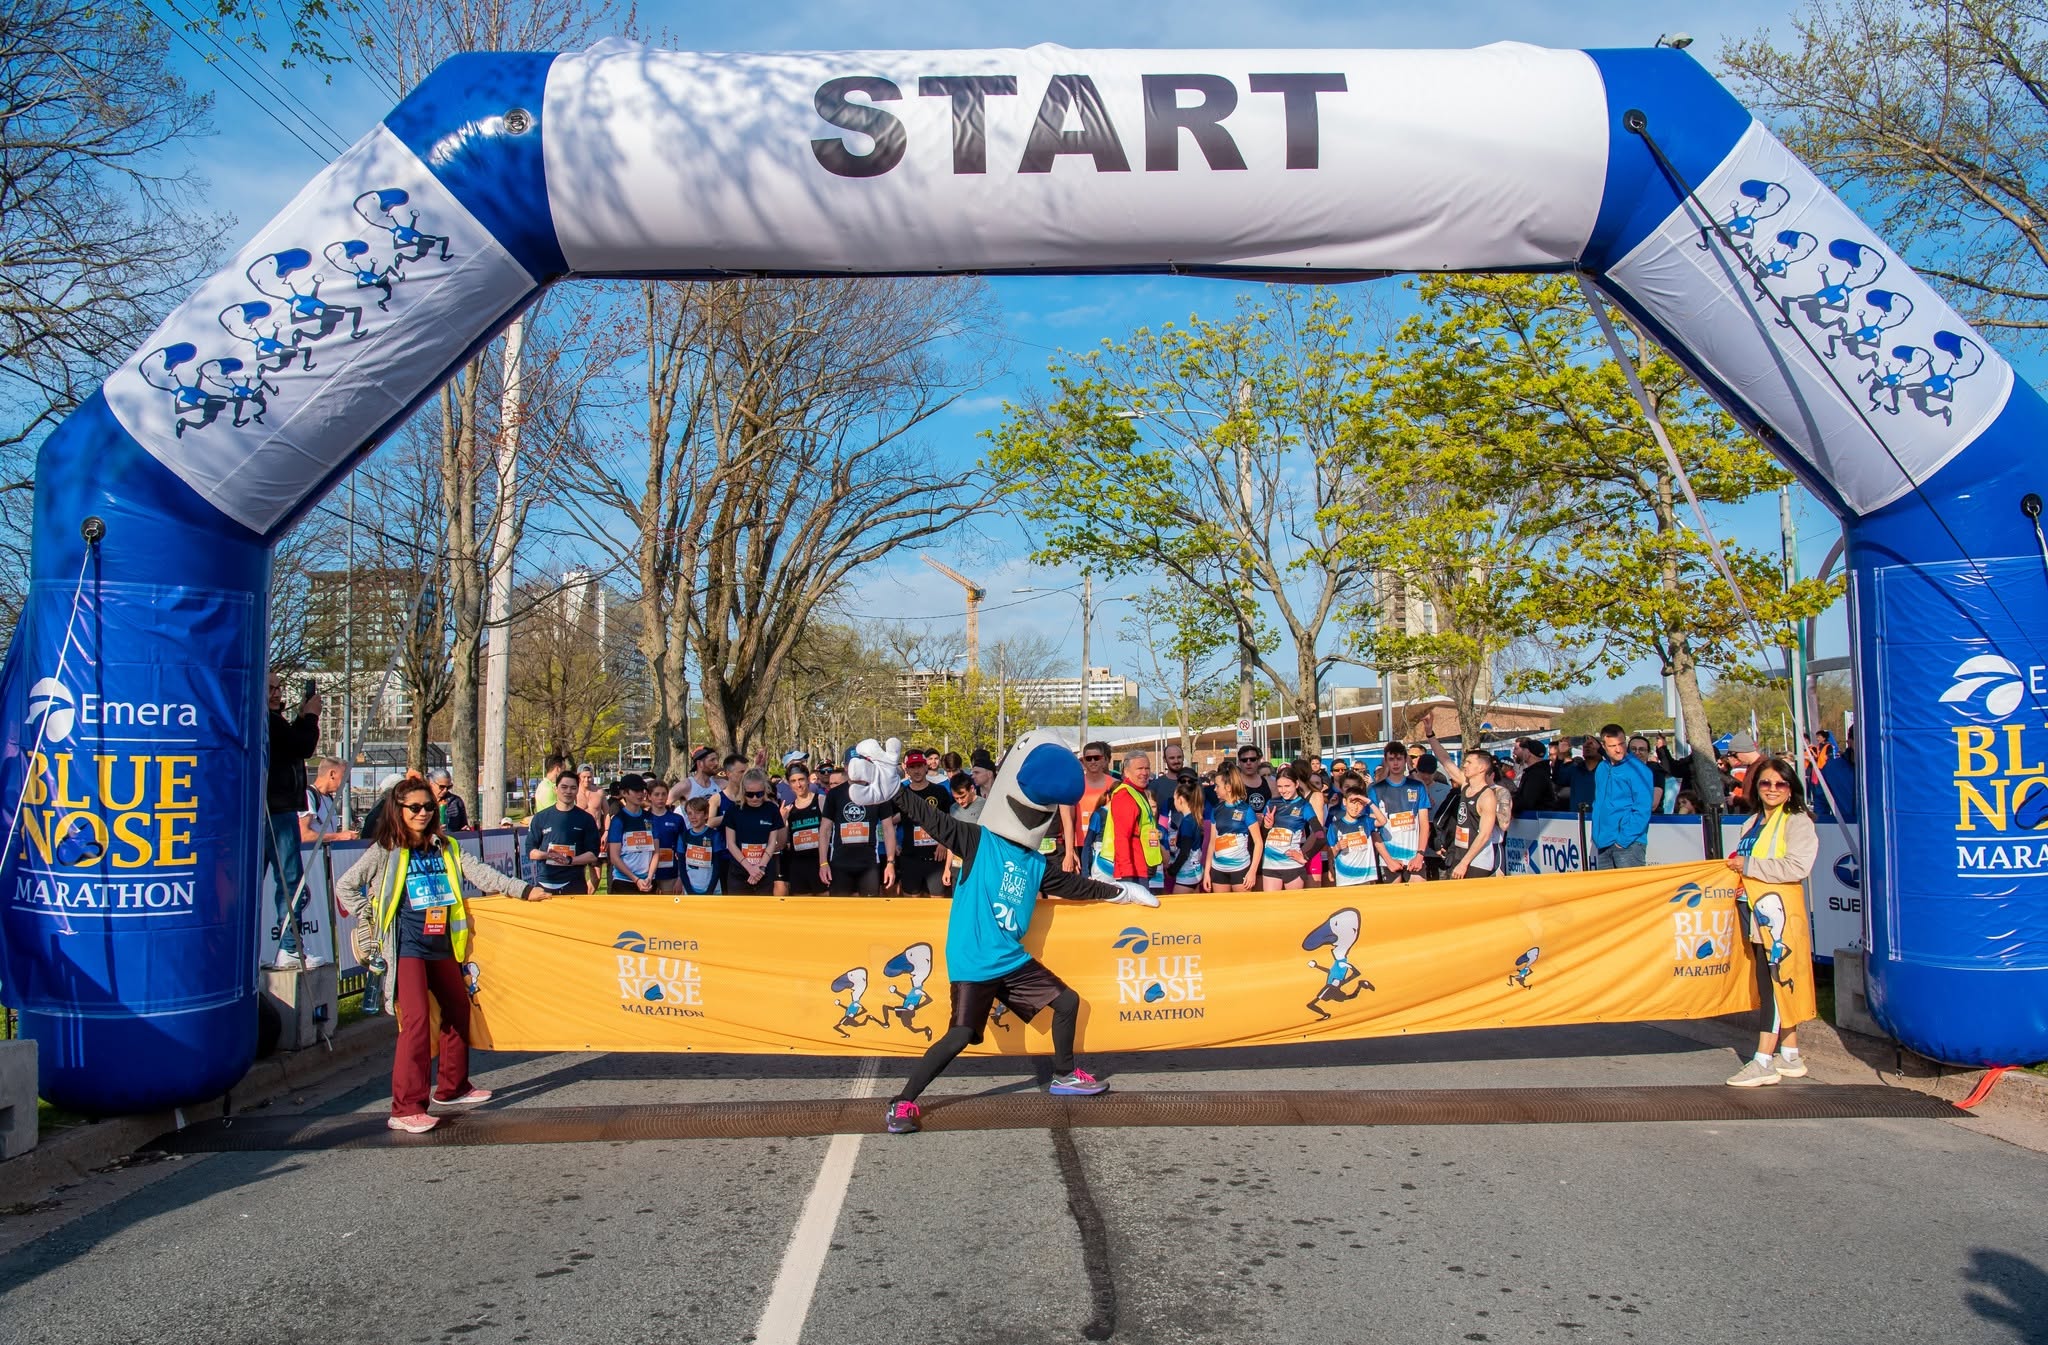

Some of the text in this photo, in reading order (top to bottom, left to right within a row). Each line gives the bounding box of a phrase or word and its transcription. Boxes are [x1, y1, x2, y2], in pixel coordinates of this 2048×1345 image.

[810, 74, 1348, 178] START
[81, 693, 198, 726] Emera
[1951, 721, 2048, 778] BL
[22, 750, 198, 811] BLUE
[19, 807, 198, 868] NOSE
[1507, 838, 1525, 849] EVENTS
[1507, 850, 1521, 861] NOVA
[1508, 861, 1527, 873] SCOTIA
[1543, 839, 1580, 873] move
[13, 875, 196, 909] MARATHON
[416, 884, 446, 897] CRW
[1000, 880, 1025, 898] NOSE
[1002, 871, 1027, 890] BLUE
[993, 902, 1018, 932] 20
[648, 936, 699, 951] Emera
[1151, 932, 1202, 946] Emera
[616, 955, 702, 983] BLUE
[1116, 954, 1203, 982] BLUE
[618, 978, 704, 1006] NOSE
[1116, 977, 1206, 1005] NOSE
[621, 1004, 705, 1018] MARATHON
[1119, 1007, 1205, 1022] MARATHON
